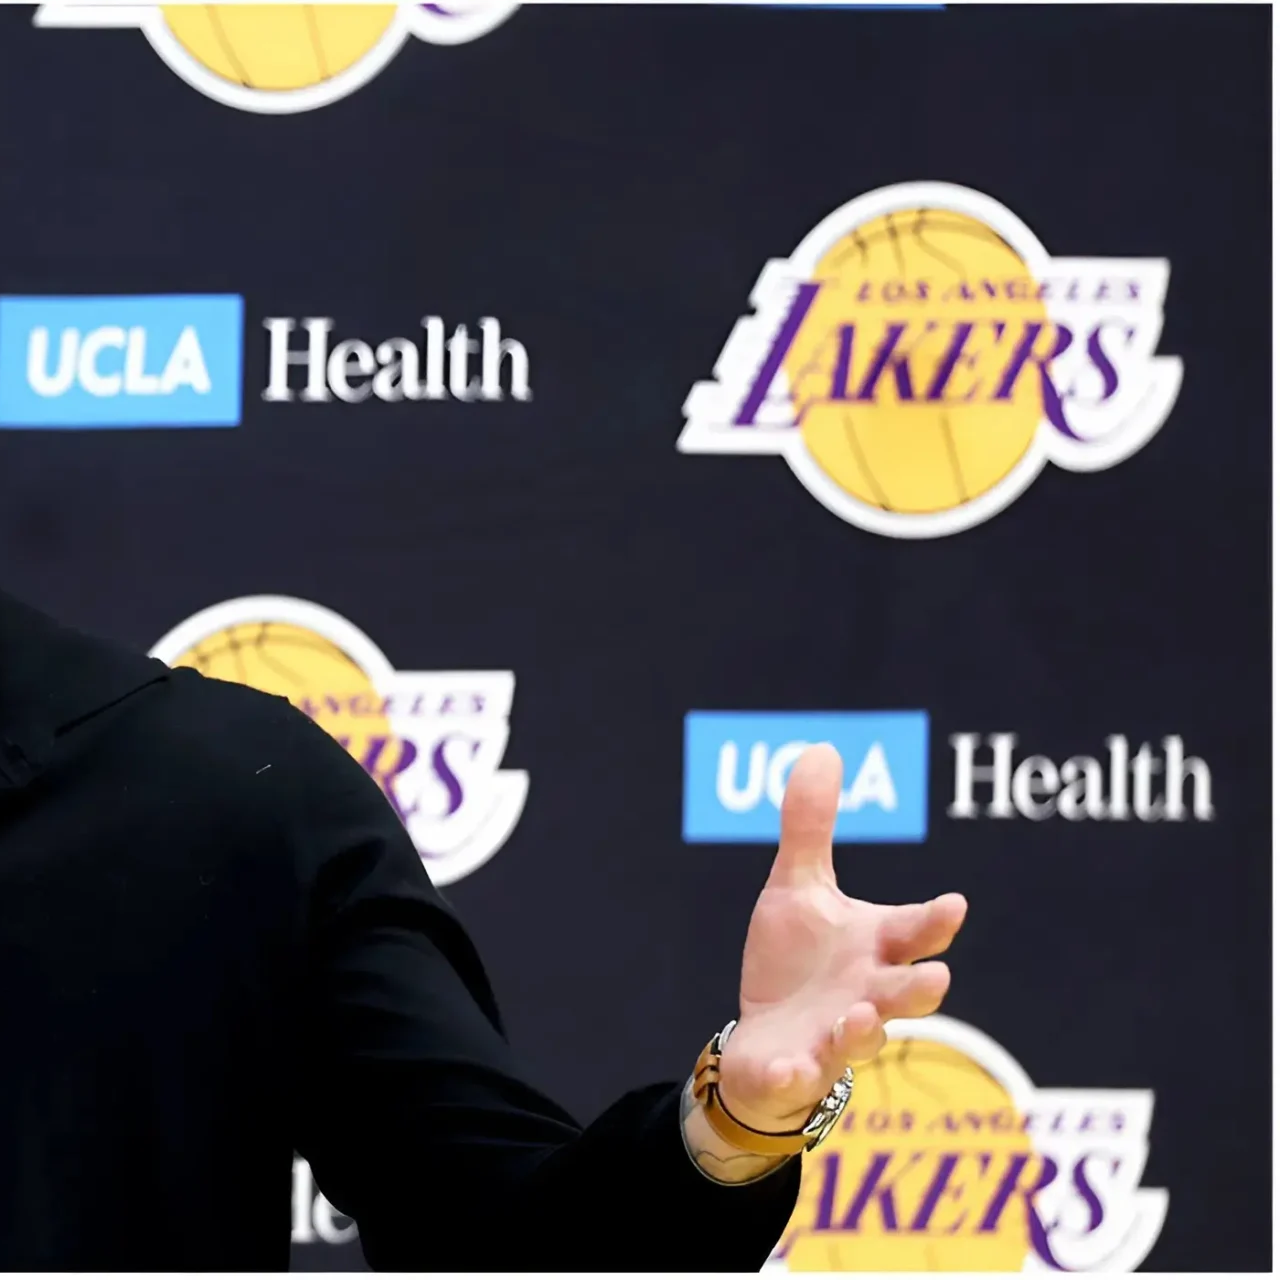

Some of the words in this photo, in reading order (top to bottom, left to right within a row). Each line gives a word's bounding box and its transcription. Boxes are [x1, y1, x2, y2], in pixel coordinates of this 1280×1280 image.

[856, 279, 929, 302] LOS
[941, 278, 1141, 302] ANGELES
[26, 325, 211, 397] UCLA
[261, 316, 533, 403] Health
[732, 281, 1138, 442] LAKERS
[716, 739, 899, 814] UCA
[946, 732, 1215, 822] Health
[841, 1108, 915, 1134] LOS
[925, 1106, 1128, 1133] ANGELES
[772, 1151, 1122, 1272] AKERS
